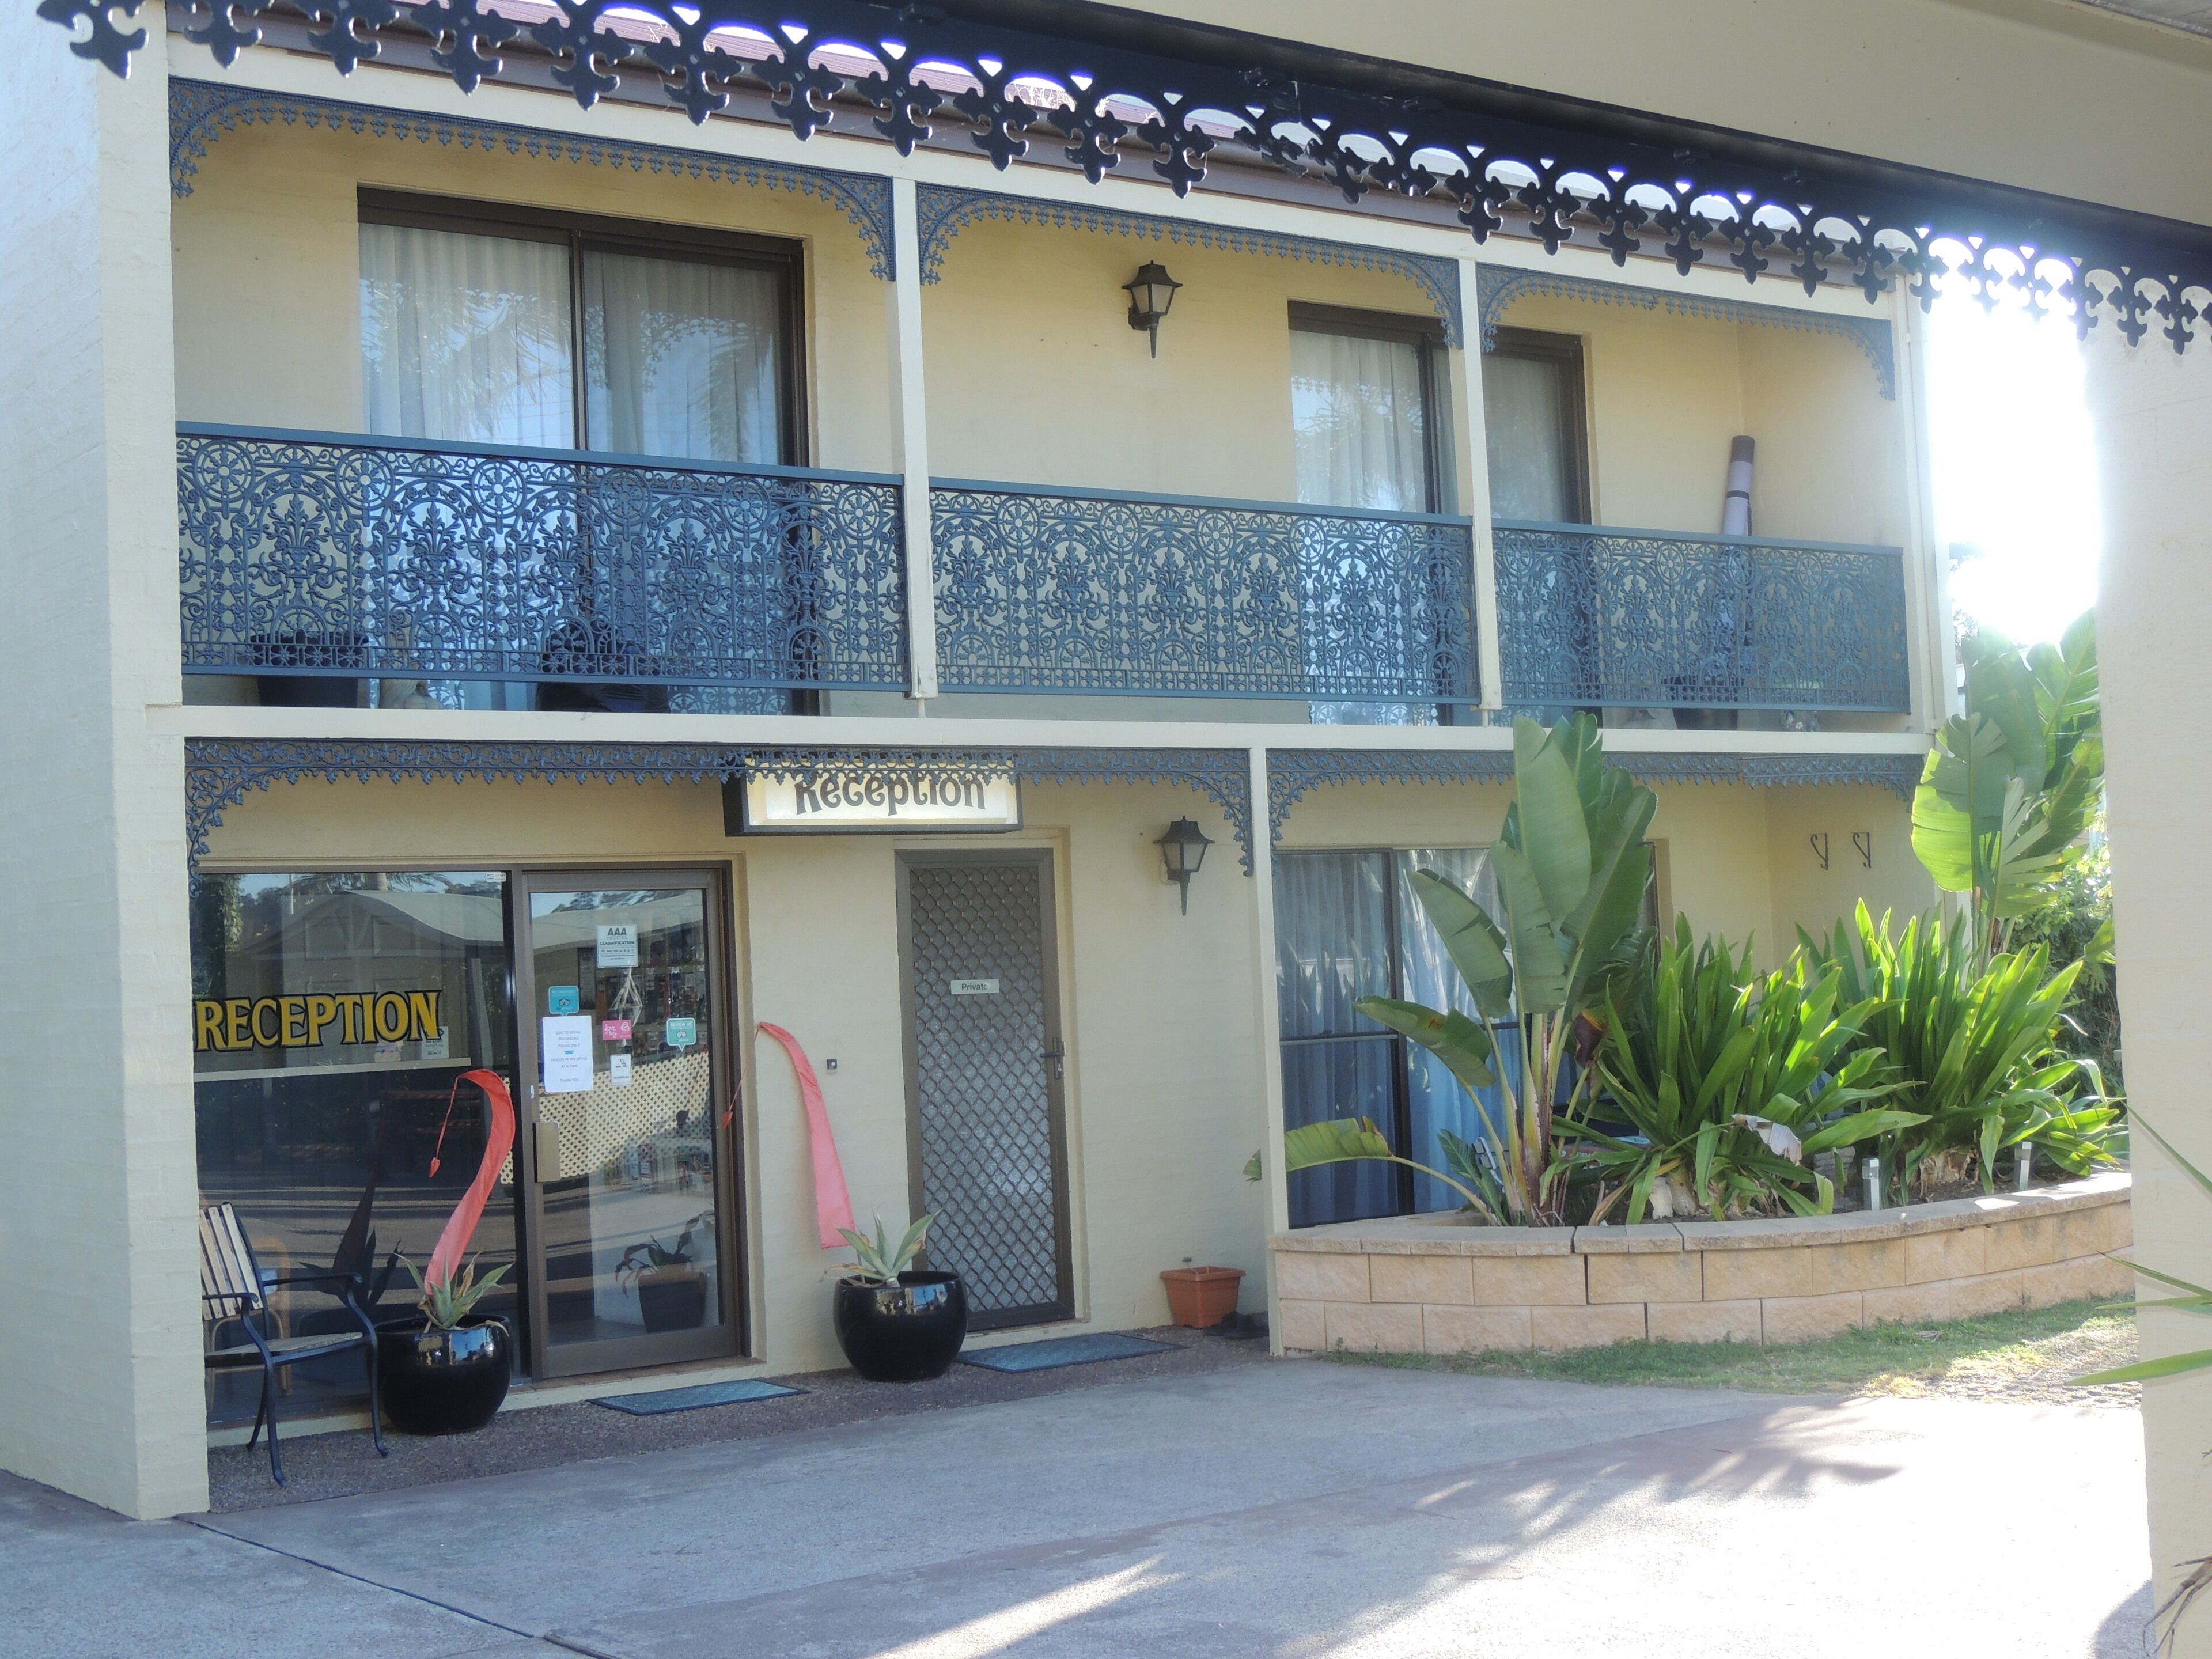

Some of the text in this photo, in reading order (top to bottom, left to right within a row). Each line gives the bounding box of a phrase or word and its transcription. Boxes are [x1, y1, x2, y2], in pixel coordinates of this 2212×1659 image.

[607, 927, 627, 935] AAA
[961, 983, 988, 991] Private
[194, 990, 442, 1052] RECEPTION
